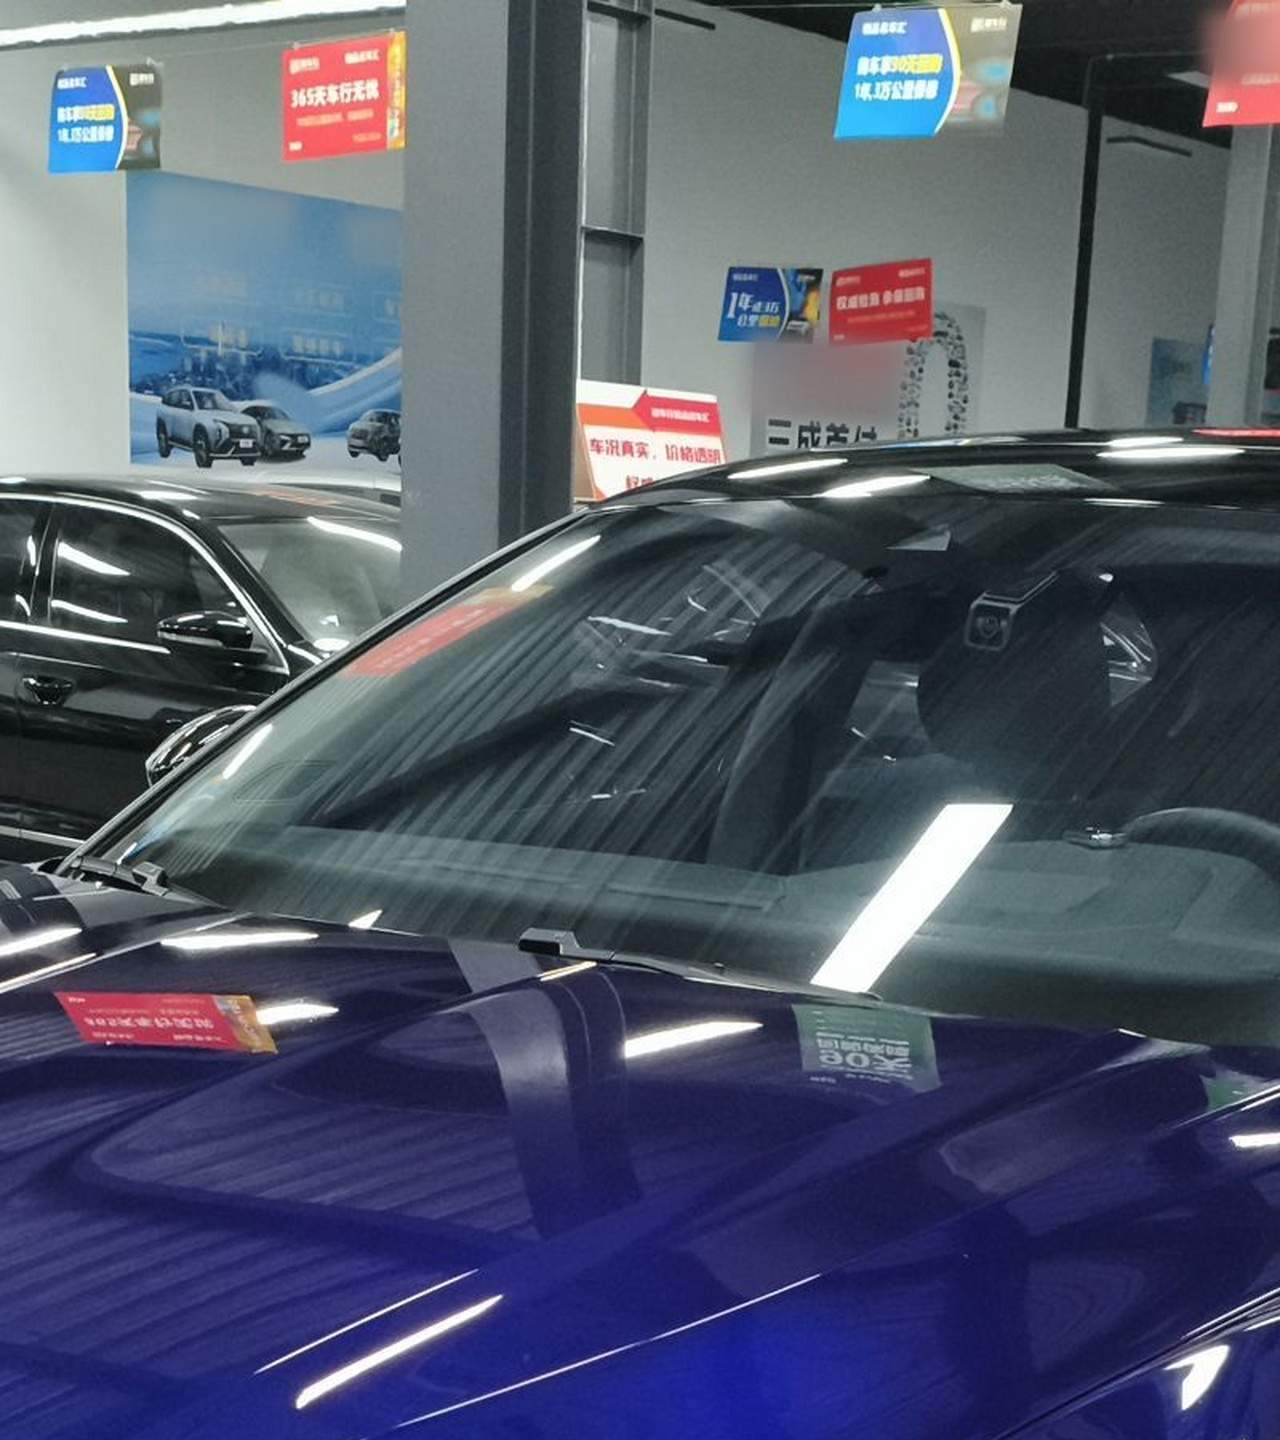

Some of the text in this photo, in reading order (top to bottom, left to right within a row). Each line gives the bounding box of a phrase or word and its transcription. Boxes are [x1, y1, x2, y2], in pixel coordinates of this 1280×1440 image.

[291, 78, 379, 108] 365天车行无忧
